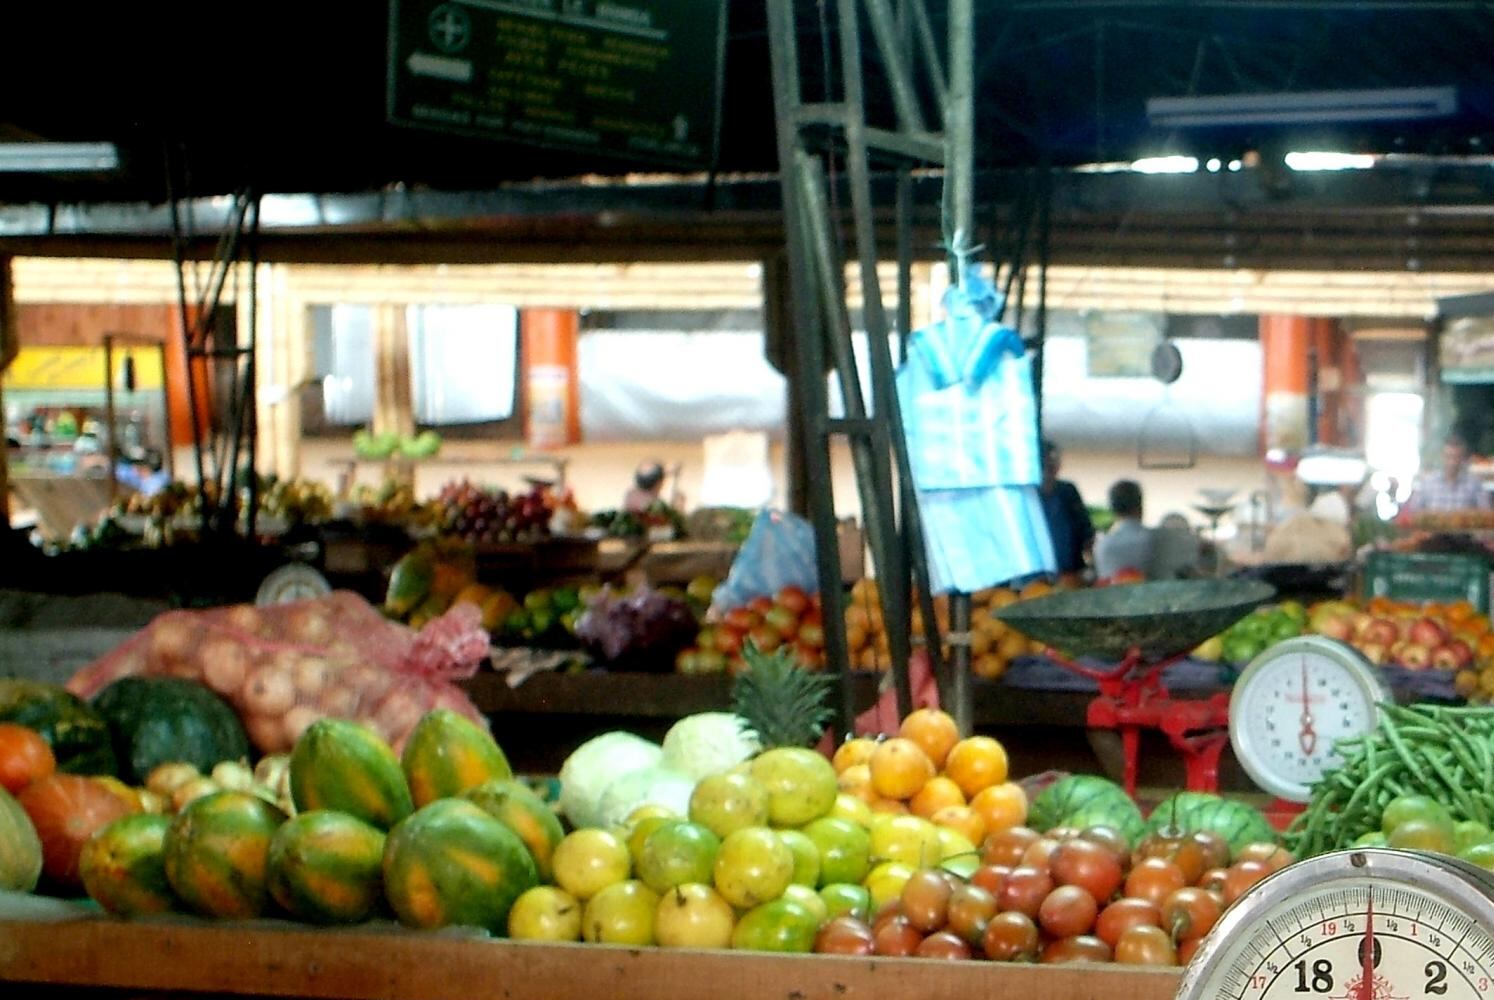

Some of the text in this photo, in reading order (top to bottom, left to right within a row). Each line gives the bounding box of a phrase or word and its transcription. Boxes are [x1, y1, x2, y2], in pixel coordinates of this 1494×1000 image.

[1322, 923, 1336, 935] 19
[1411, 924, 1417, 935] 1
[1295, 960, 1333, 993] 18
[1425, 961, 1447, 994] 2
[1252, 977, 1266, 989] 17
[1479, 978, 1488, 991] 3
